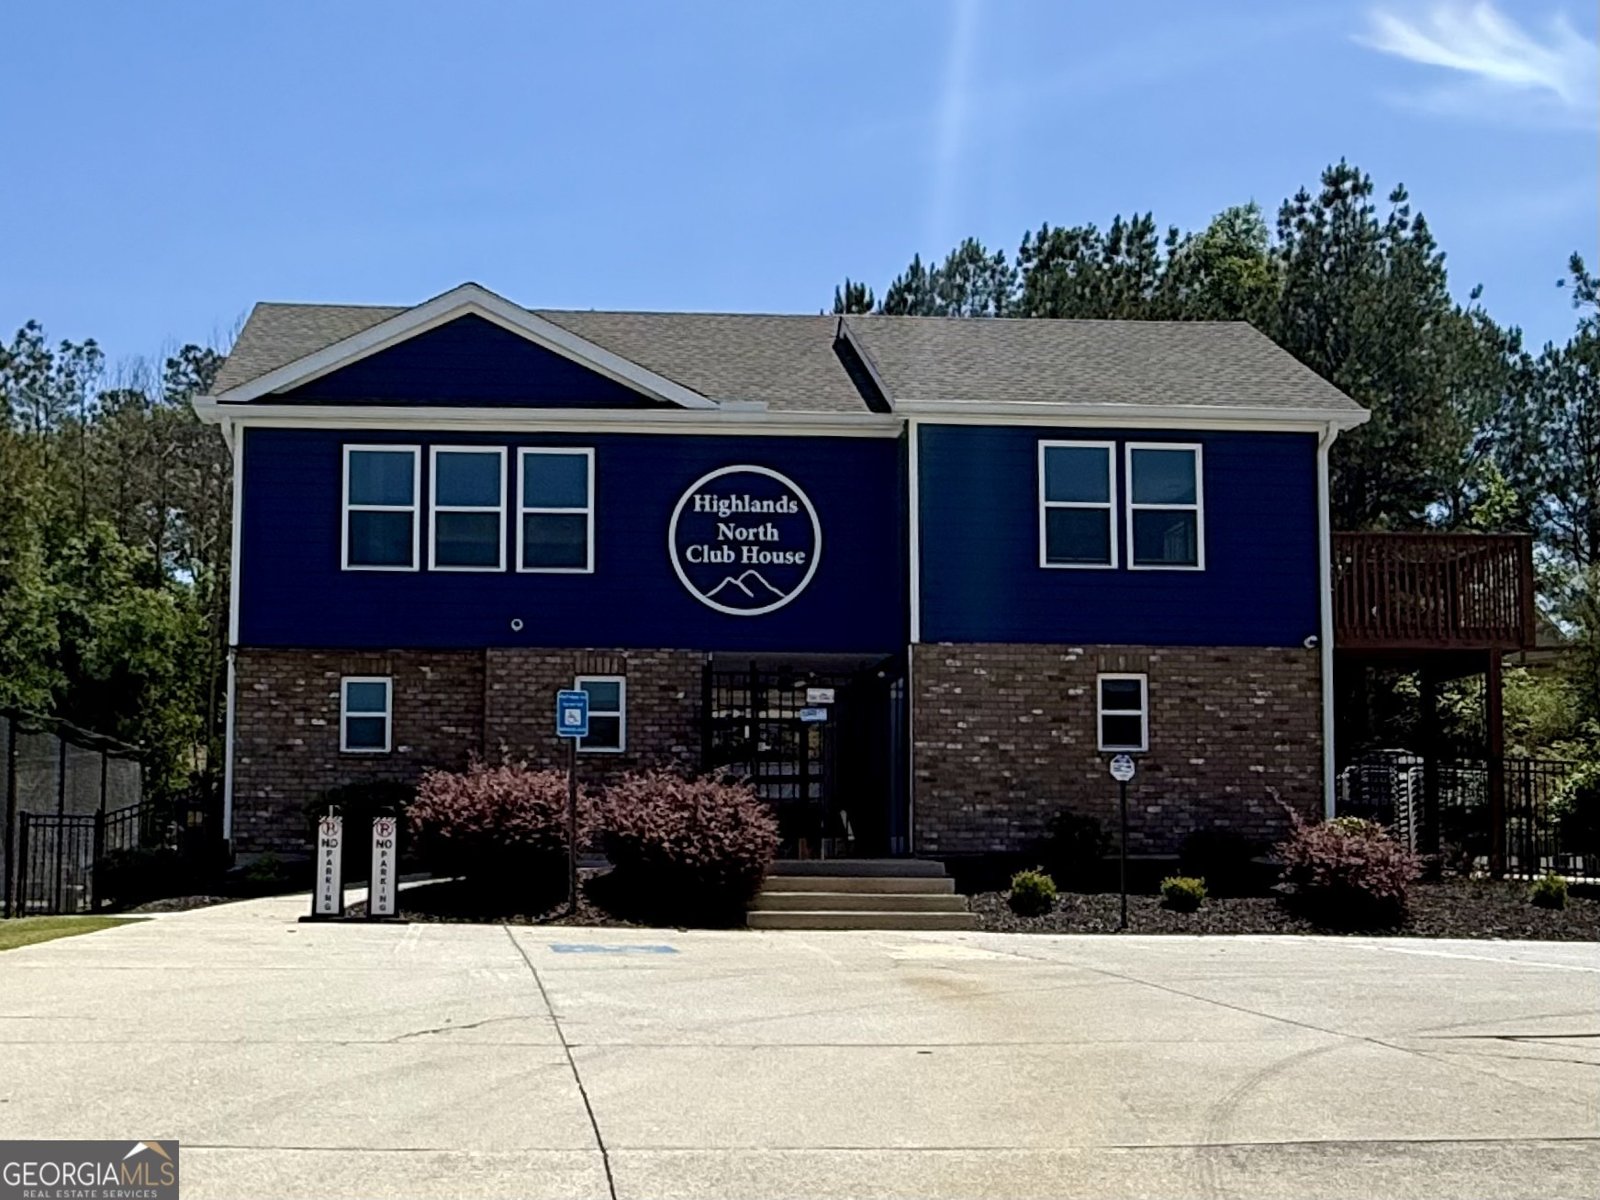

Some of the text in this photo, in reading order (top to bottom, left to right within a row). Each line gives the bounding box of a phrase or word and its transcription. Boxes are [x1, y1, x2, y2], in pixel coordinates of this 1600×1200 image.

[693, 494, 799, 518] Highlands
[716, 522, 780, 541] North
[686, 544, 806, 564] Club House
[375, 839, 393, 849] NO
